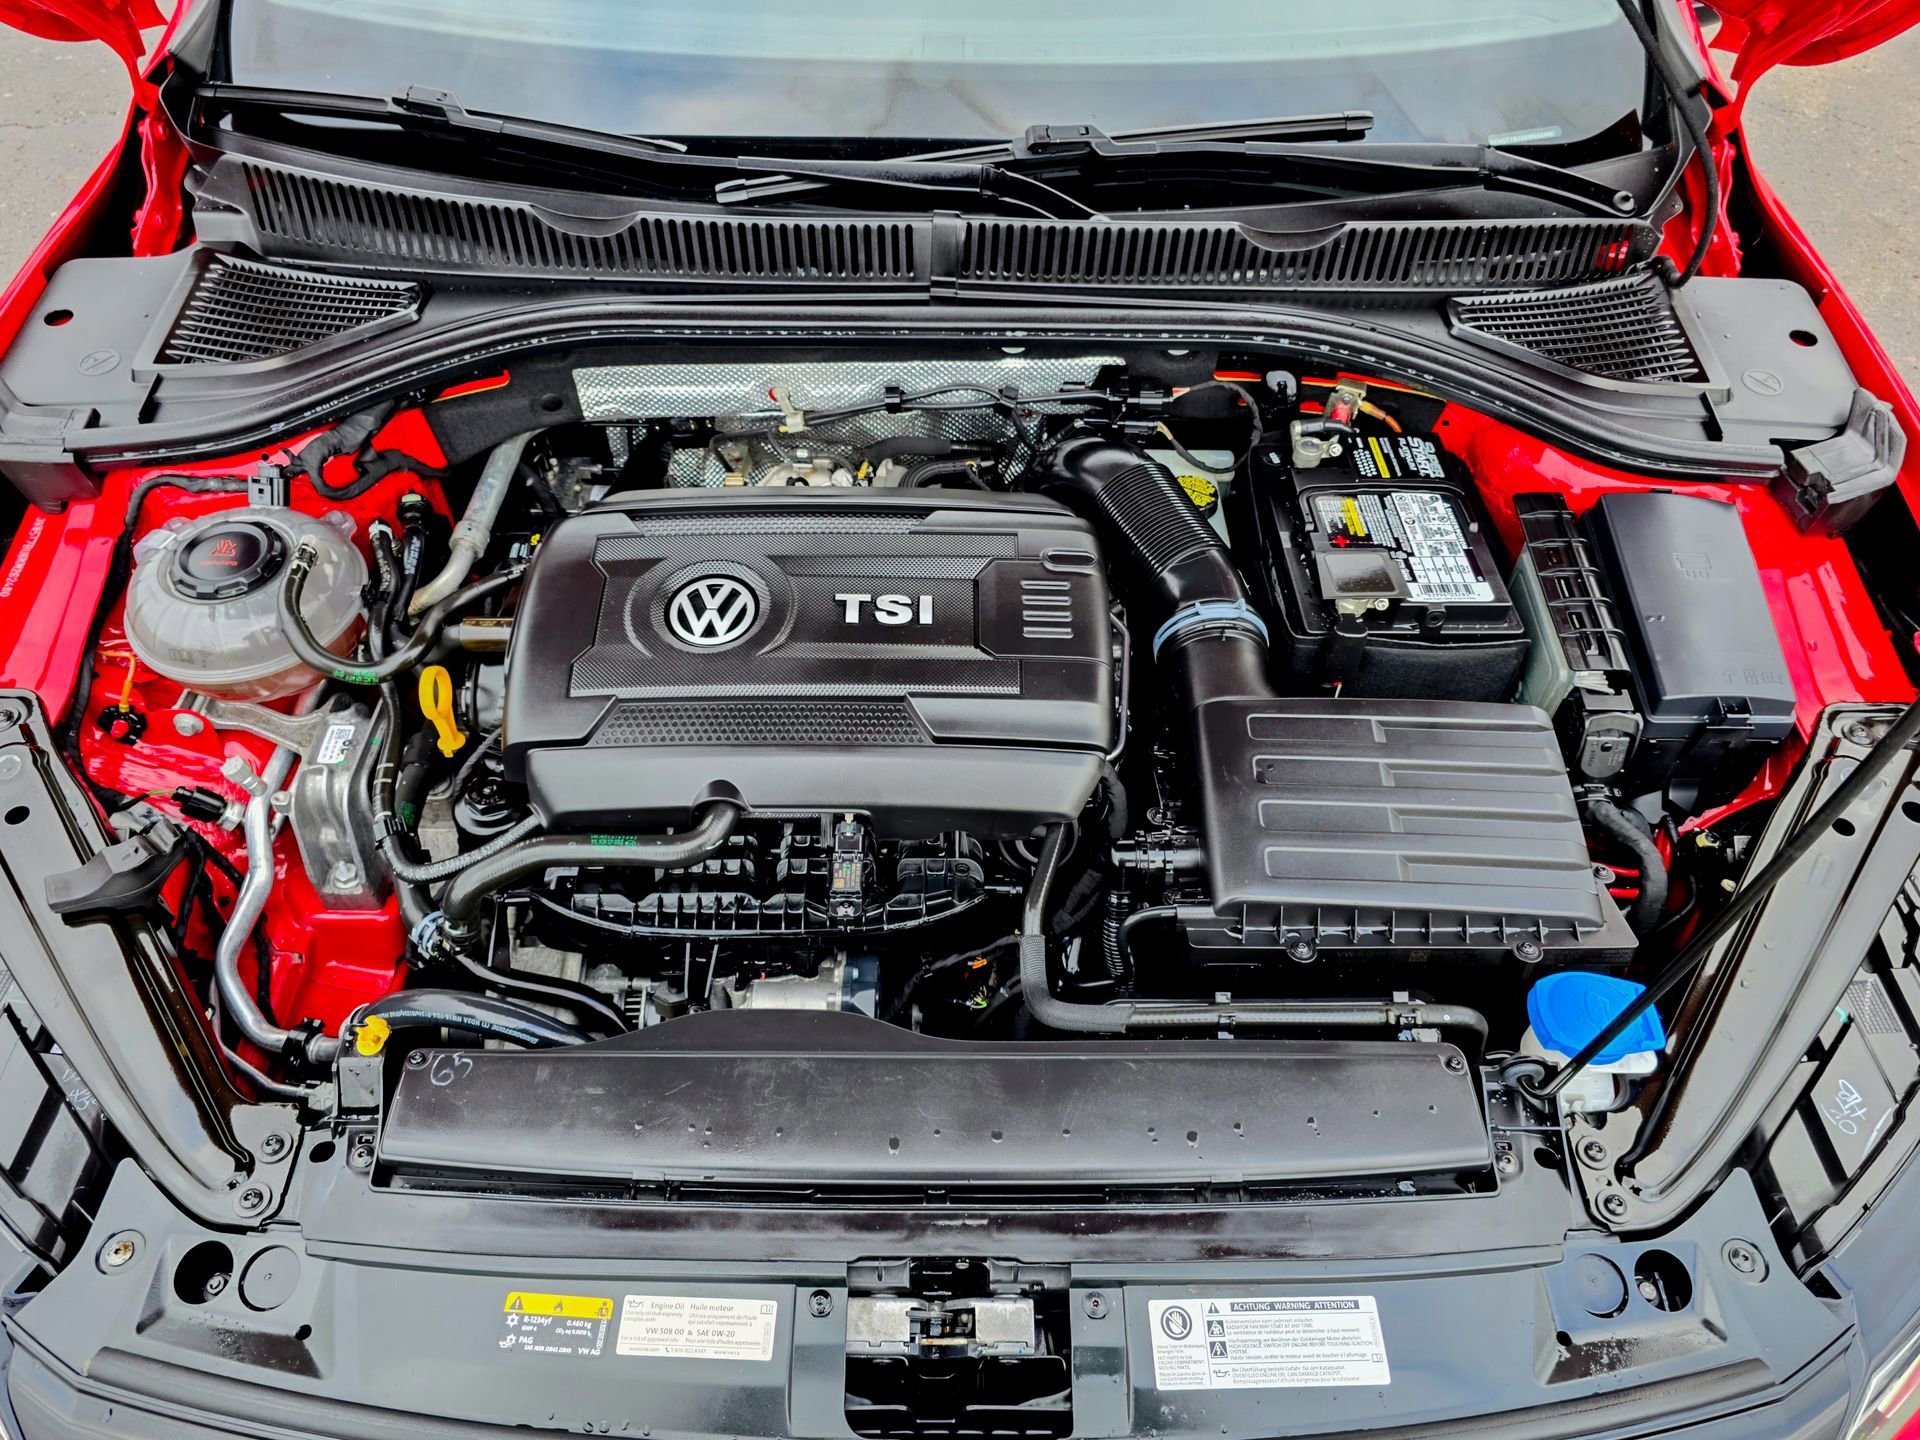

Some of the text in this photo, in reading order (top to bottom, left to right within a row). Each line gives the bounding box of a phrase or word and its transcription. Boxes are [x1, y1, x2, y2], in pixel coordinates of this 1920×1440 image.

[1407, 436, 1433, 478] START
[1425, 441, 1445, 478] SUPER
[669, 578, 933, 645] VW TSI
[651, 1302, 734, 1312] Engine Oil Huile moteur
[1233, 1301, 1355, 1311] ACHTUNG WARNING ATTENTION
[523, 1315, 592, 1329] R-1234yf 0.460 kg
[646, 1327, 659, 1335] VW
[660, 1327, 673, 1335] 508
[696, 1329, 710, 1337] SAE
[518, 1336, 533, 1344] PAG
[590, 1348, 601, 1356] AG
